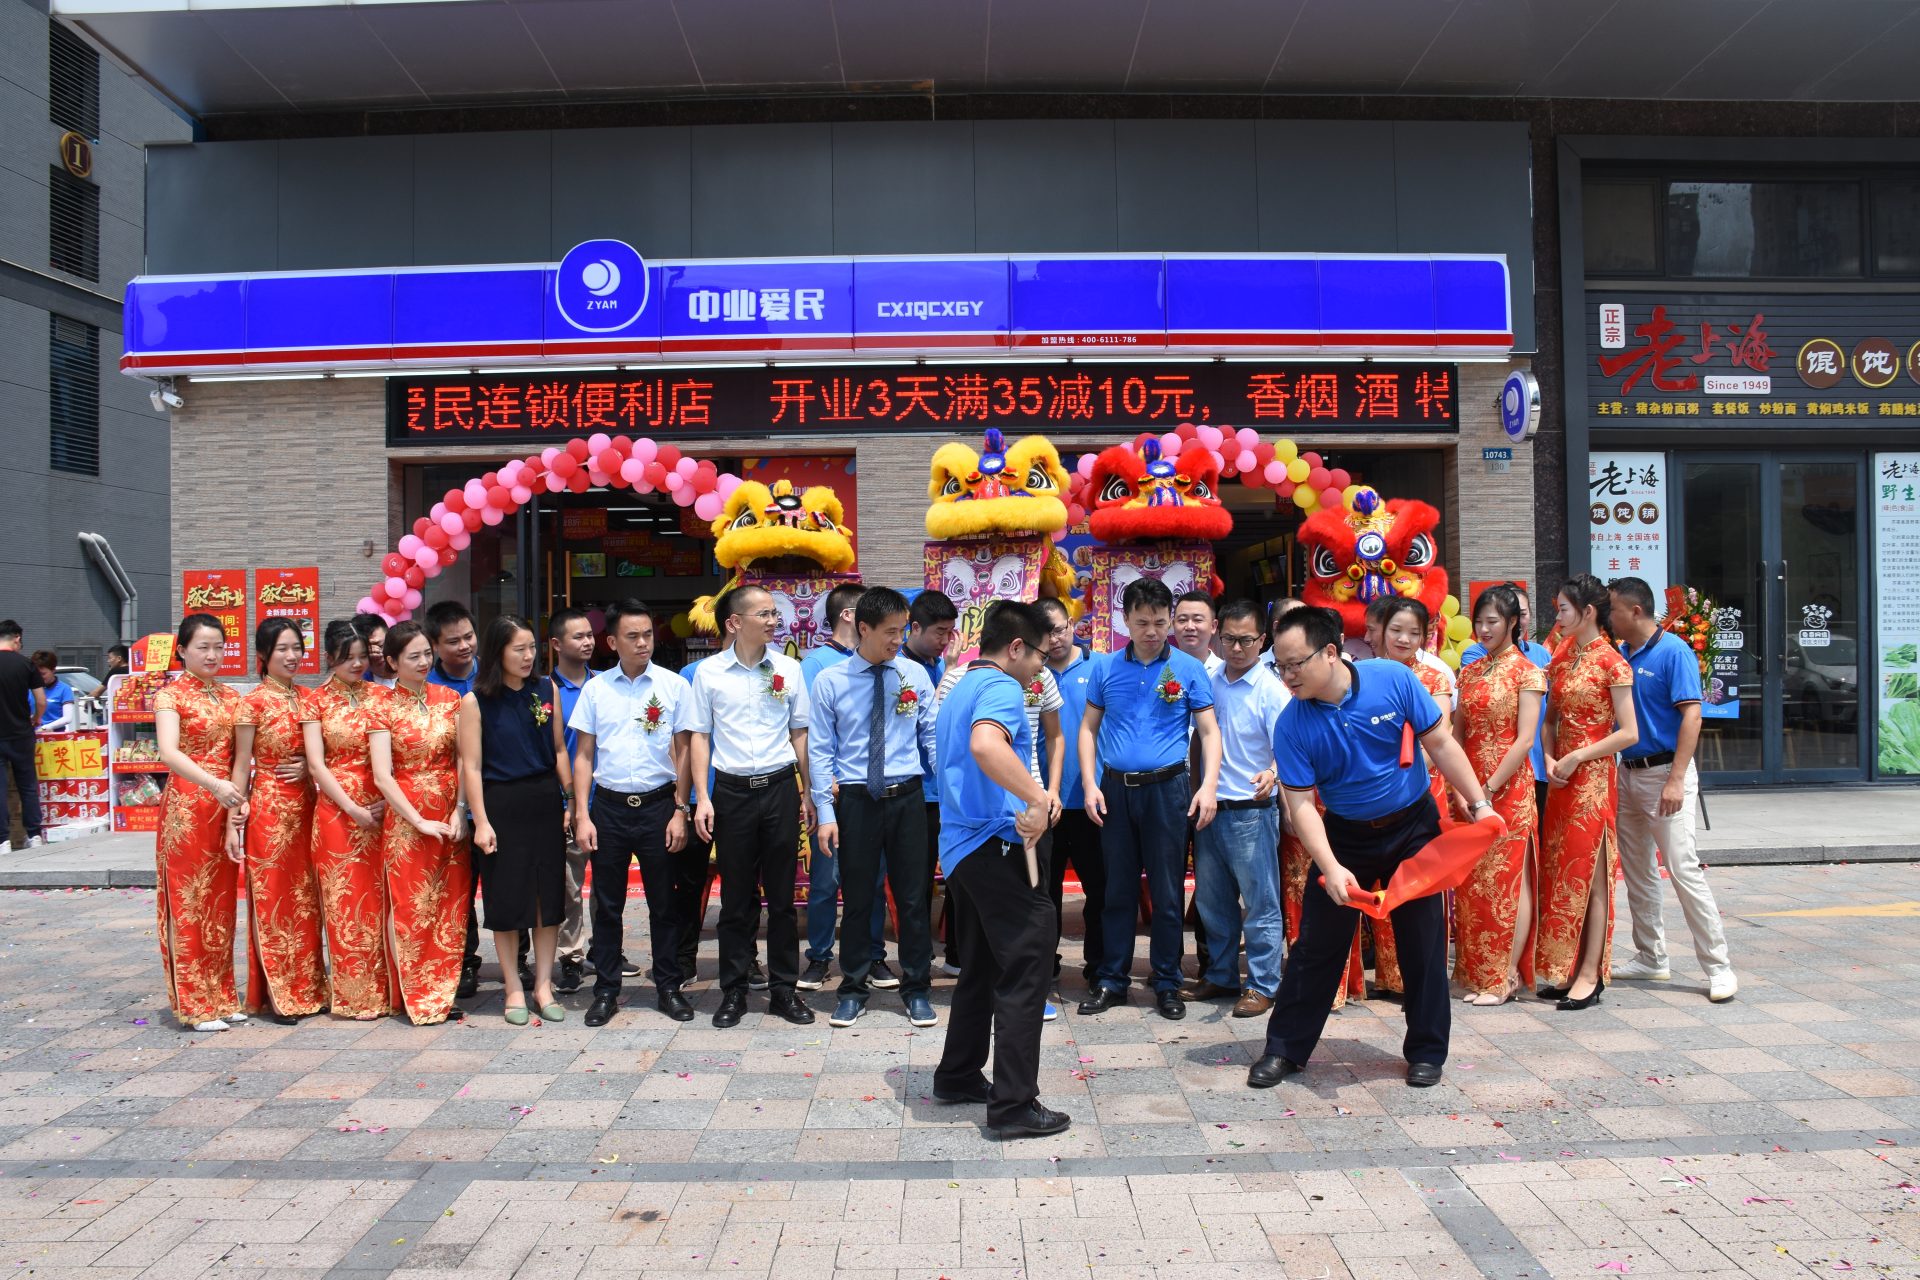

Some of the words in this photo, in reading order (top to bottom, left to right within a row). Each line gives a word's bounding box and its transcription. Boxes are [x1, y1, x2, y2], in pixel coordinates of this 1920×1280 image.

[586, 300, 618, 310] ZYAM
[689, 288, 825, 322] 中业爱民
[1604, 309, 1621, 343] 正宗
[1597, 305, 1777, 396] 老上海
[1246, 371, 1338, 419] 香烟
[1355, 373, 1399, 418] 酒
[1707, 381, 1739, 390] Since
[1743, 381, 1769, 390] 1949
[1712, 402, 1749, 415] 套餐饭
[1759, 402, 1797, 415] 炒粉面
[1807, 402, 1869, 415] 黄焖鸡米饭
[1878, 402, 1920, 416] 药膳炖
[1484, 451, 1507, 459] 10743
[1590, 461, 1659, 497] 老上海
[1882, 484, 1920, 501] 野生
[1592, 507, 1656, 519] 馄饨铺
[1627, 533, 1660, 541] 全国连锁
[185, 583, 245, 608] 盛大开业
[259, 581, 316, 605] 盛大开业
